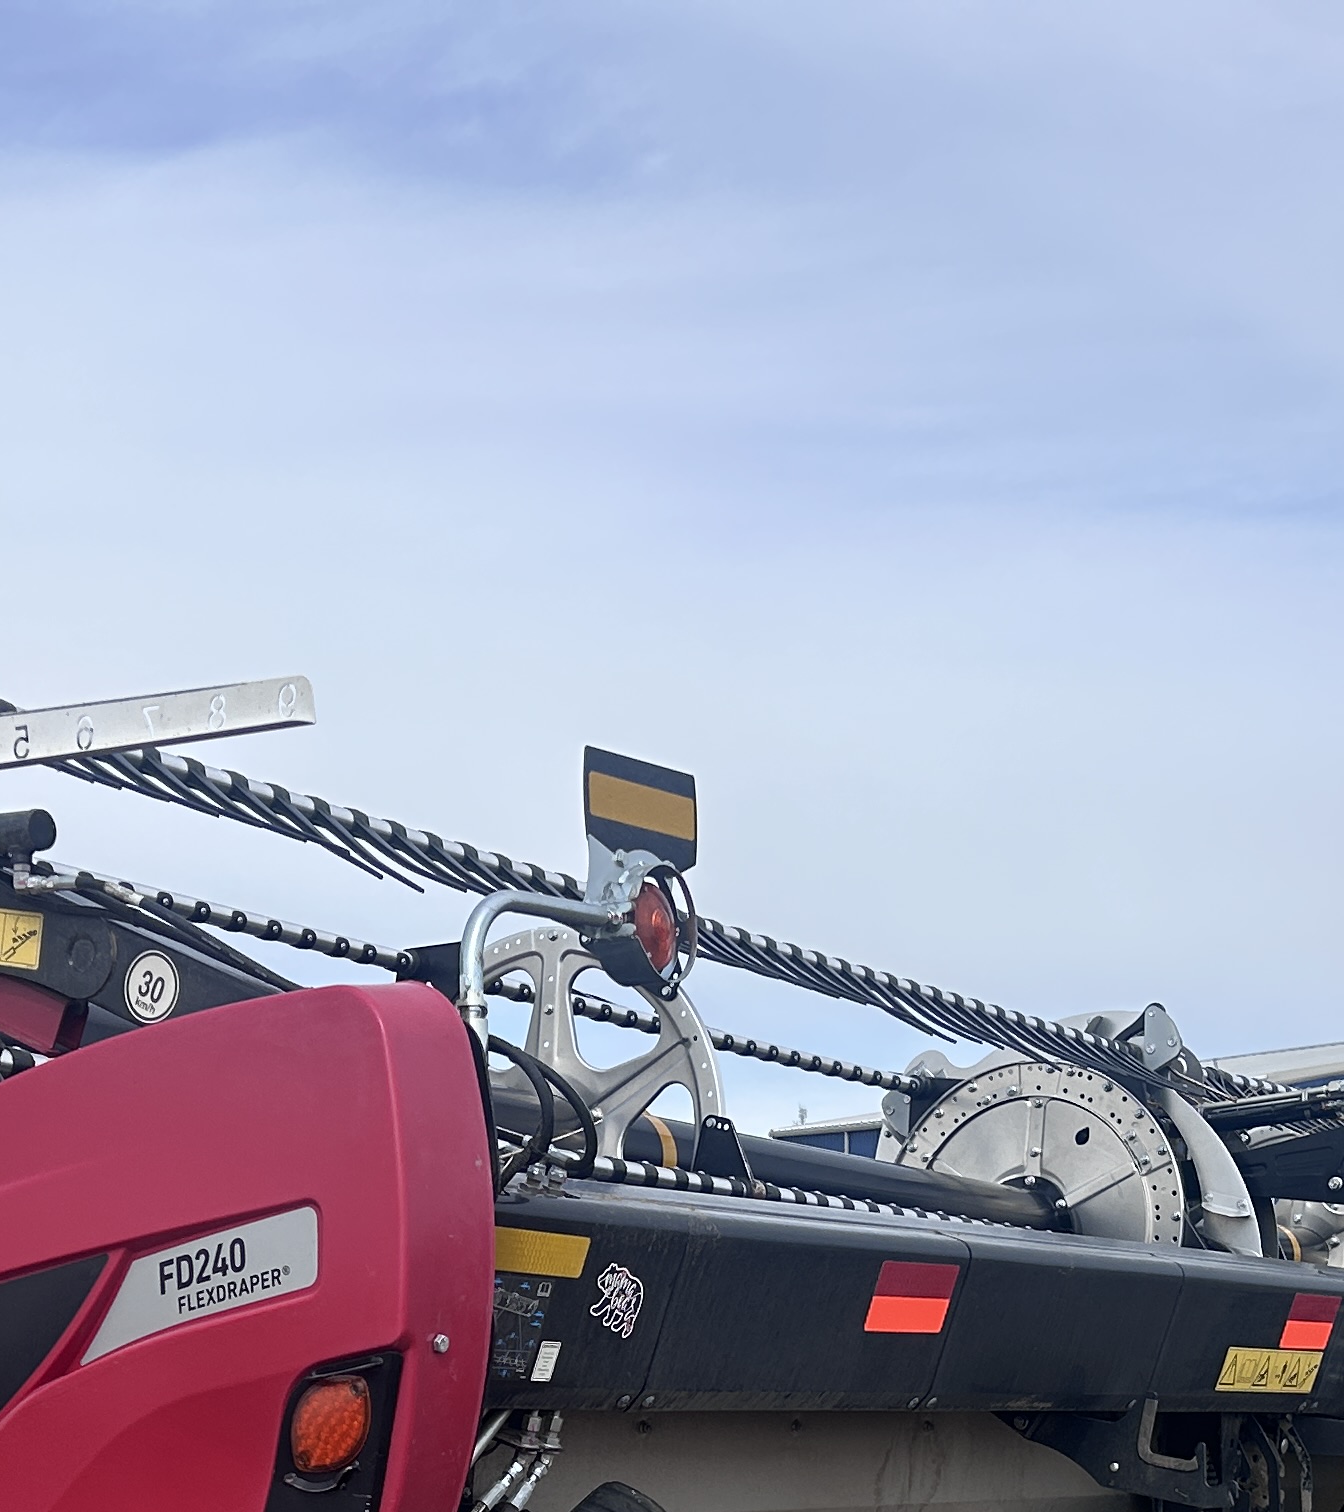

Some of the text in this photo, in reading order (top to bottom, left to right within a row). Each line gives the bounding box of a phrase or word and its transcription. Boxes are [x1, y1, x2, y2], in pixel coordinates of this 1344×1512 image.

[138, 970, 166, 1004] 30
[135, 996, 156, 1016] km/h
[159, 1237, 247, 1296] FD240
